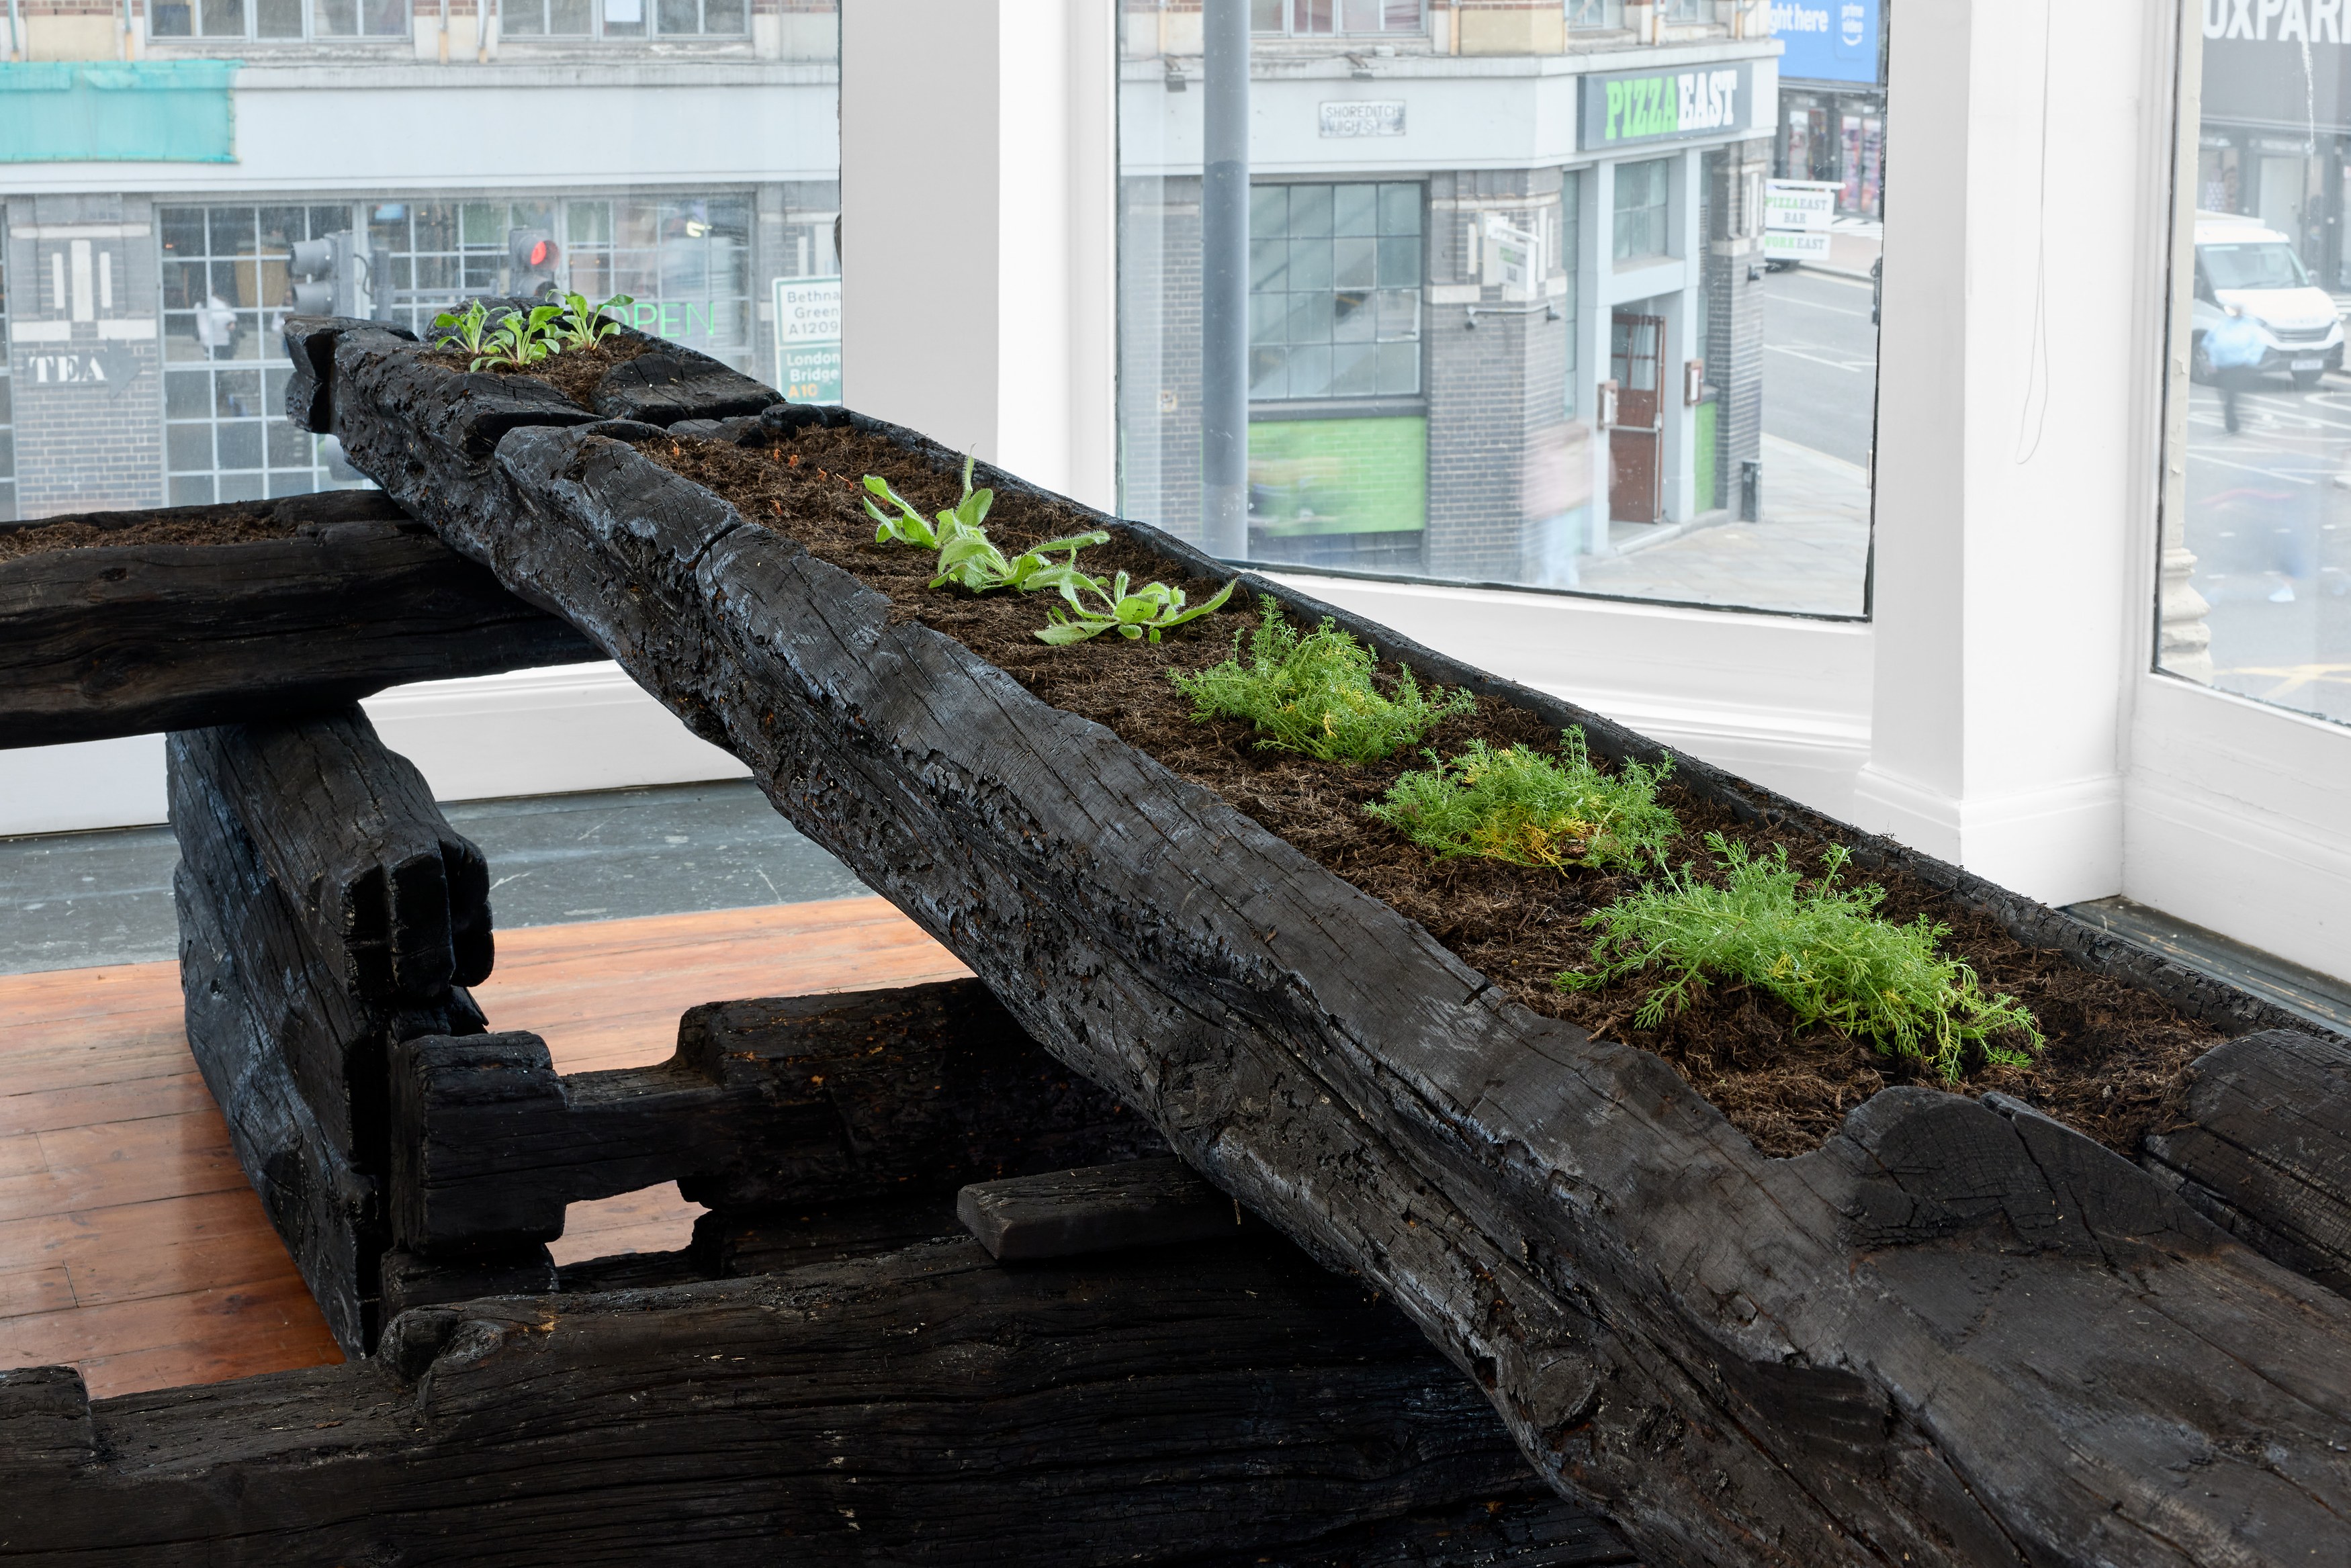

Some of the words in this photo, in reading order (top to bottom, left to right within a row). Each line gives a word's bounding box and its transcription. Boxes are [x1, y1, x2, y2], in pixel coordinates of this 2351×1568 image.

[1794, 3, 1828, 32] here
[1326, 105, 1401, 118] SHOREDITCH
[1783, 212, 1806, 224] BAR
[795, 306, 839, 319] Green
[787, 351, 840, 367] London
[29, 355, 107, 383] TEA
[790, 367, 839, 383] Bridge
[788, 383, 818, 398] A10
